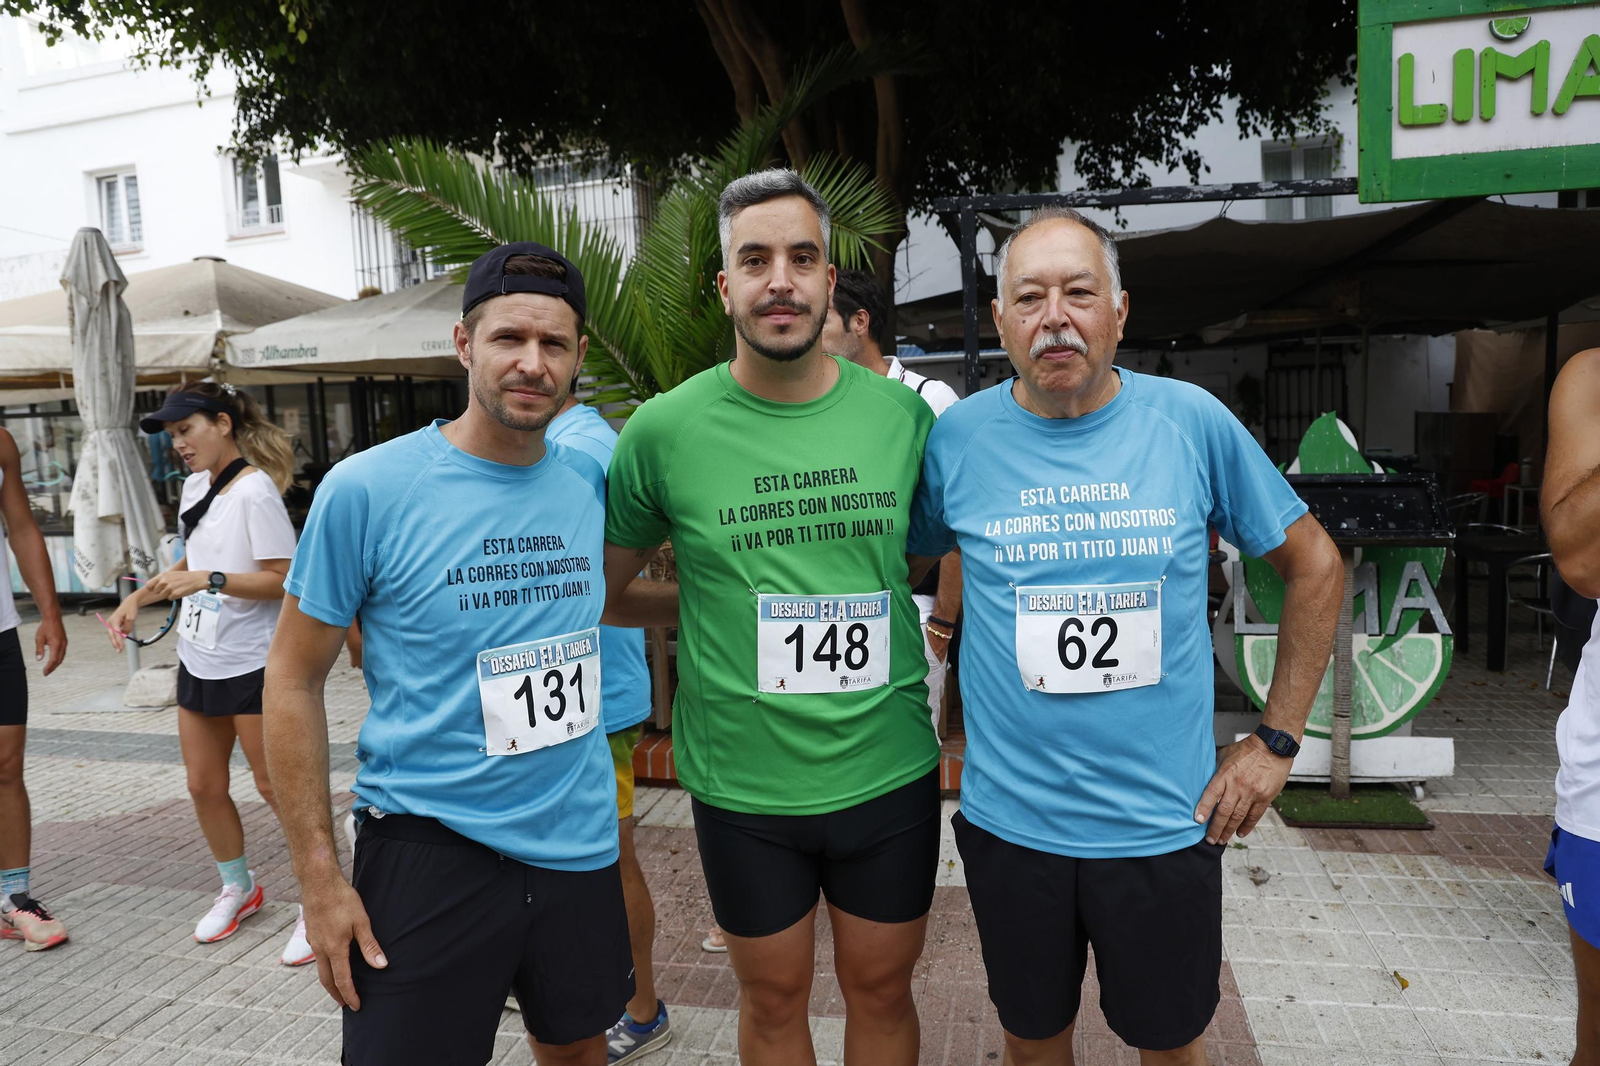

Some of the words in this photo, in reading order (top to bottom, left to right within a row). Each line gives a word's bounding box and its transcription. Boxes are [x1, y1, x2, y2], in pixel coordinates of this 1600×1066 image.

[1398, 34, 1600, 127] LIMA
[259, 343, 317, 362] Alhambra
[754, 475, 790, 494] ESTA
[793, 467, 858, 489] CARRERA
[1020, 487, 1056, 506] ESTA
[1060, 482, 1130, 504] CARRERA
[719, 508, 737, 526] LA
[740, 501, 795, 523] CORRES
[798, 496, 827, 516] CON
[831, 491, 897, 512] NOSOTROS
[984, 520, 1001, 537] LA
[1005, 514, 1060, 535] CORRES
[1064, 512, 1095, 532] CON
[1099, 507, 1176, 530] NOSOTROS
[483, 538, 515, 556] ESTA
[518, 535, 566, 553] CARRERA
[744, 532, 764, 550] VA
[766, 528, 795, 547] POR
[797, 525, 812, 543] TI
[815, 522, 847, 541] TITO
[851, 518, 883, 538] JUAN
[1005, 544, 1025, 562] VA
[1029, 542, 1059, 561] POR
[1062, 541, 1077, 559] TI
[1081, 539, 1116, 558] TITO
[1120, 536, 1158, 557] JUAN
[447, 568, 464, 586] LA
[468, 563, 518, 583] CORRES
[521, 561, 544, 578] CON
[547, 556, 591, 576] NOSOTROS
[472, 592, 491, 609] VA
[494, 589, 518, 607] POR
[521, 588, 532, 604] TI
[534, 584, 560, 602] TITO
[561, 581, 583, 599] JUAN
[1028, 593, 1074, 611] DESAFÍO
[1077, 591, 1108, 615] ELA
[1109, 591, 1147, 610] TARIFA
[1232, 561, 1453, 636] LA
[770, 600, 816, 618] DESAFÍO
[820, 600, 847, 622] ELA
[849, 601, 882, 618] TARIFA
[490, 648, 537, 675] DESAFÍO
[539, 642, 566, 670] ELA
[565, 638, 592, 660] TARIFA
[784, 622, 869, 673] 148
[1057, 616, 1119, 670] 62
[848, 676, 872, 685] TARIFA
[1112, 674, 1138, 683] TARIFA
[513, 662, 585, 728] 131
